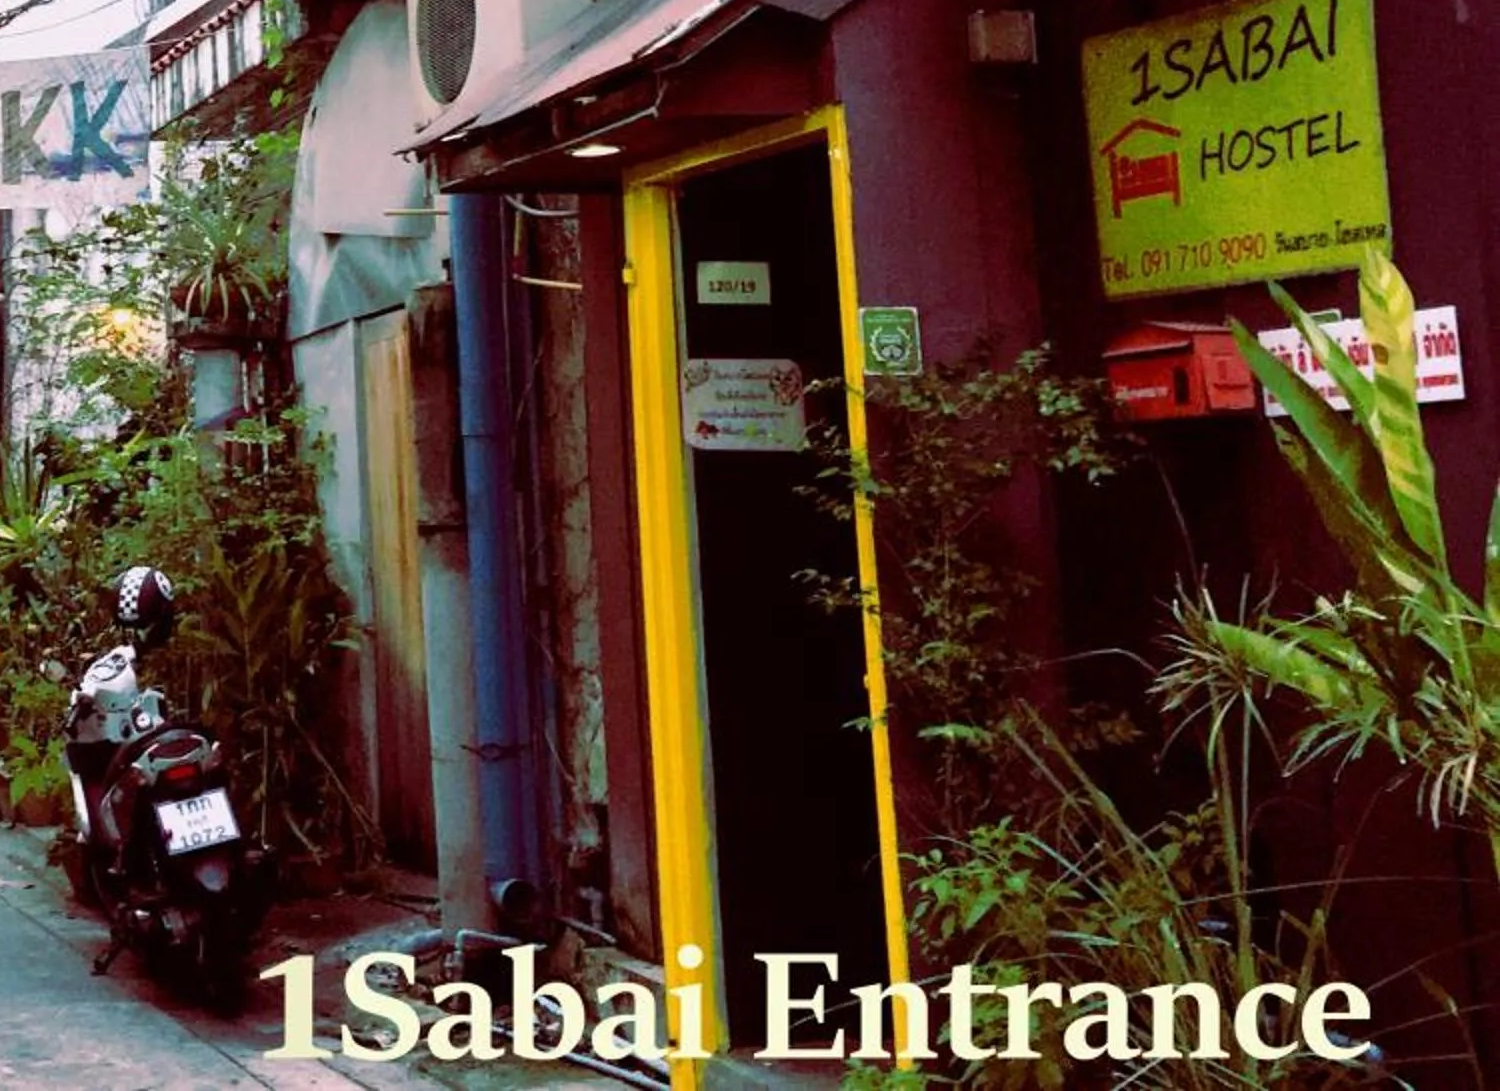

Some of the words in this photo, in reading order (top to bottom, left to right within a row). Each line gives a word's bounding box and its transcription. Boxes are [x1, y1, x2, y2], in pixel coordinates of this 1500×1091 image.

[1201, 110, 1360, 180] HOSTEL
[1141, 249, 1170, 277] 091
[1177, 242, 1211, 271] 710
[1218, 233, 1267, 263] 9090
[180, 825, 226, 847] 1072
